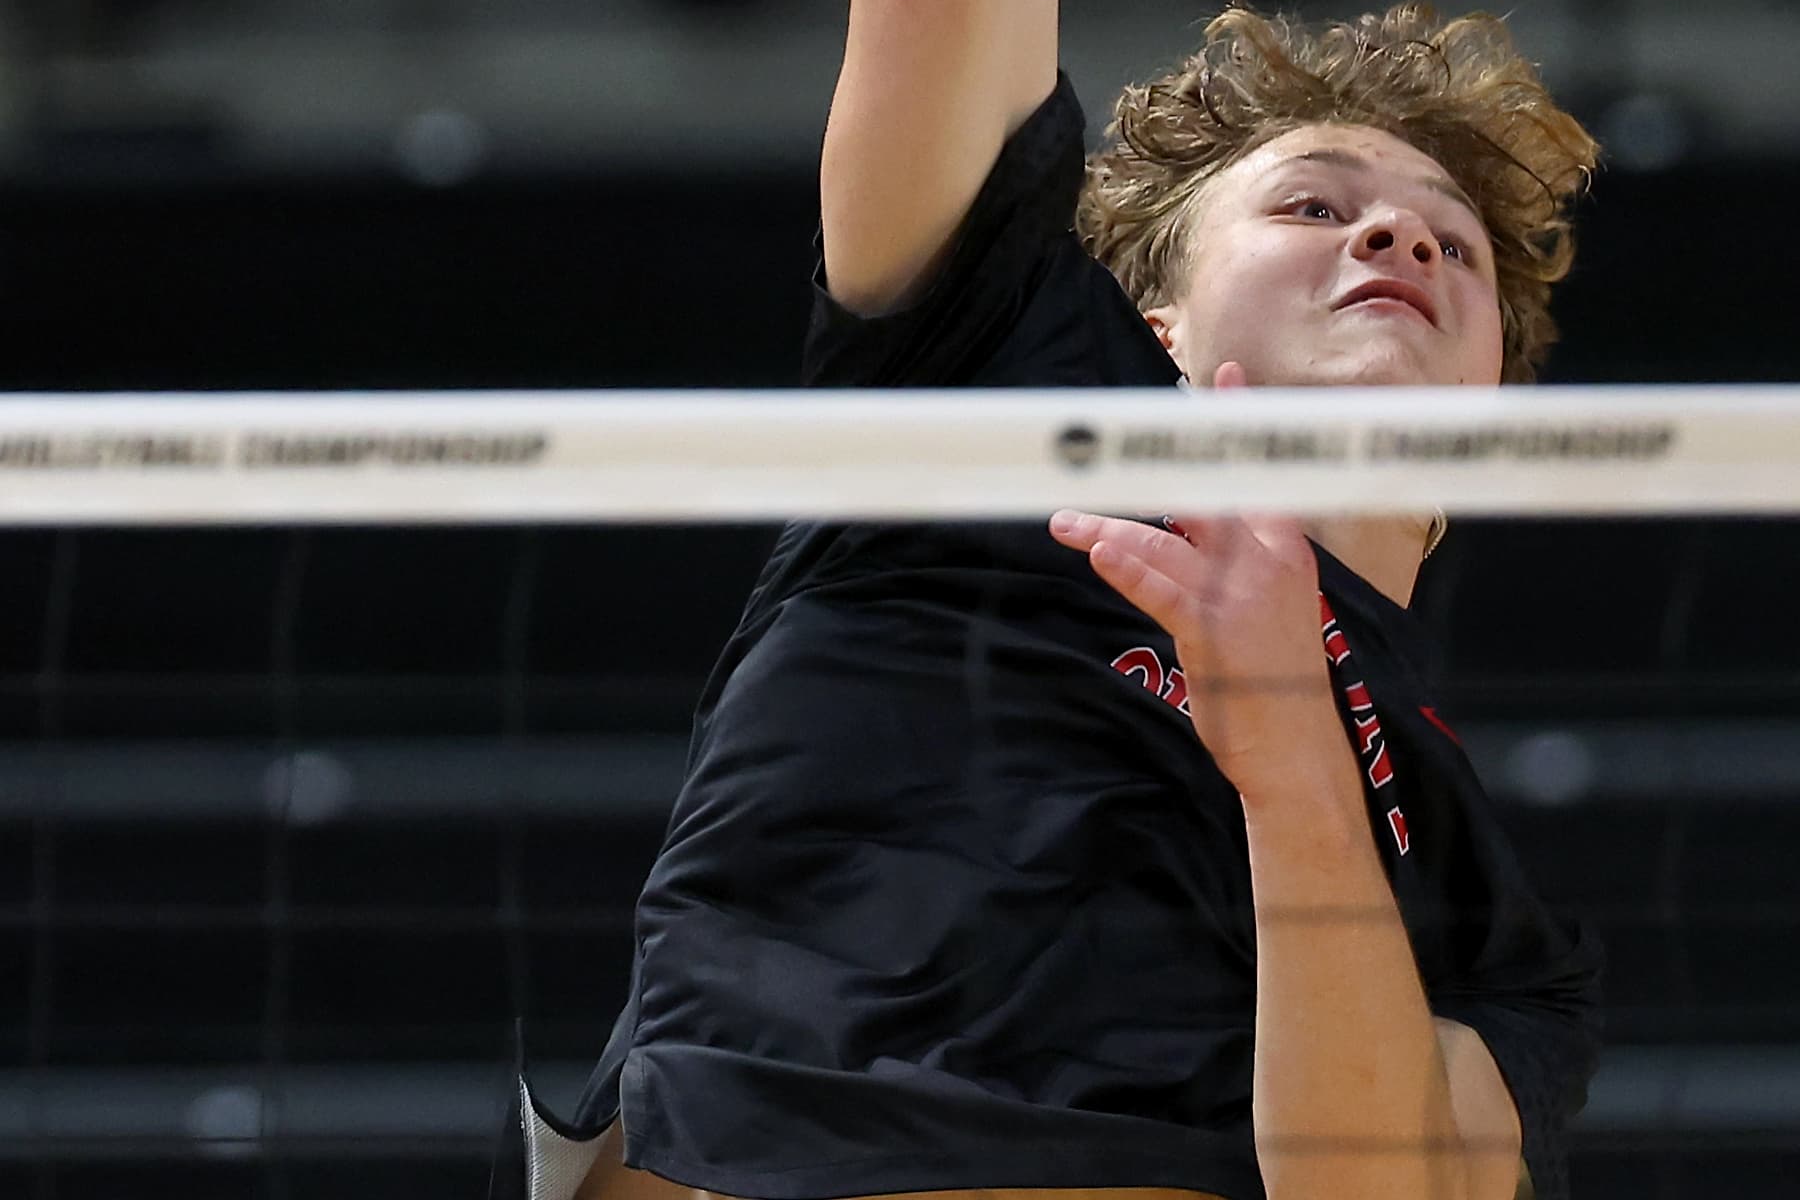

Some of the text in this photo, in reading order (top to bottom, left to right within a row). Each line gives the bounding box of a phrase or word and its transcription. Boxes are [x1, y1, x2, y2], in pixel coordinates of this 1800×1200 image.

[238, 429, 549, 467] CHAMPIONSHIP
[1117, 422, 1679, 462] VOLLEYBALL CHAMPIONSHIP
